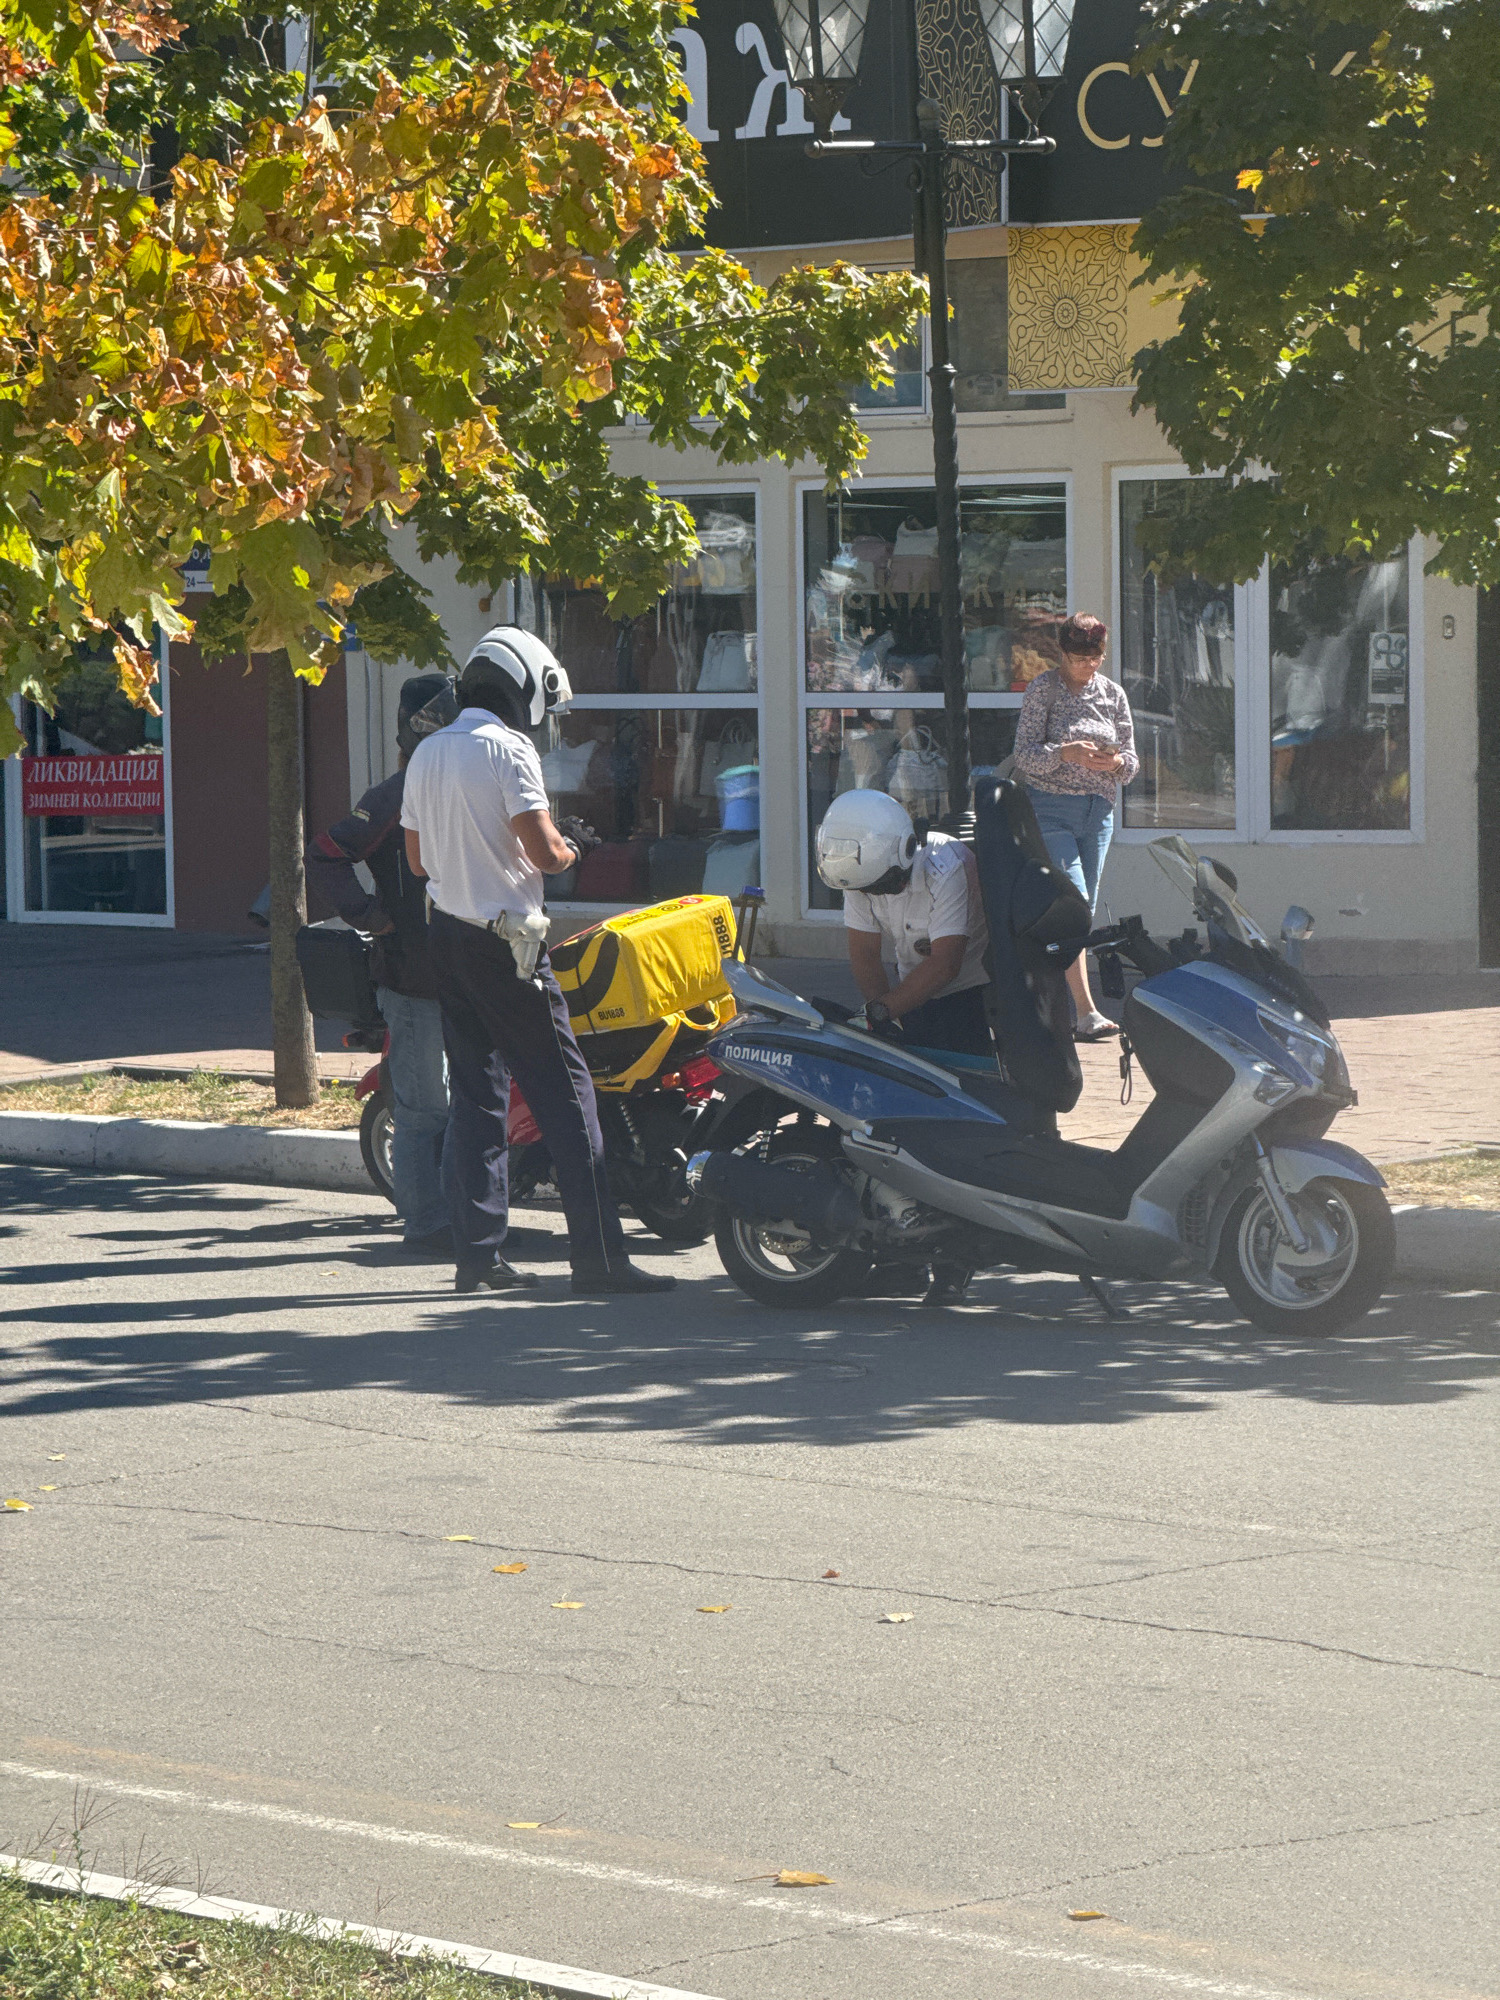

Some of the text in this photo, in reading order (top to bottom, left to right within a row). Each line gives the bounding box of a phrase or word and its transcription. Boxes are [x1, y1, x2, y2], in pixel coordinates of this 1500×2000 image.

[26, 759, 160, 787] ЛИКВИДАЦИЯ
[27, 789, 162, 810] ЗИМНЕЙ КОЛЛЕКЦИИ
[724, 1045, 793, 1067] ПОЛИЦИЯ
